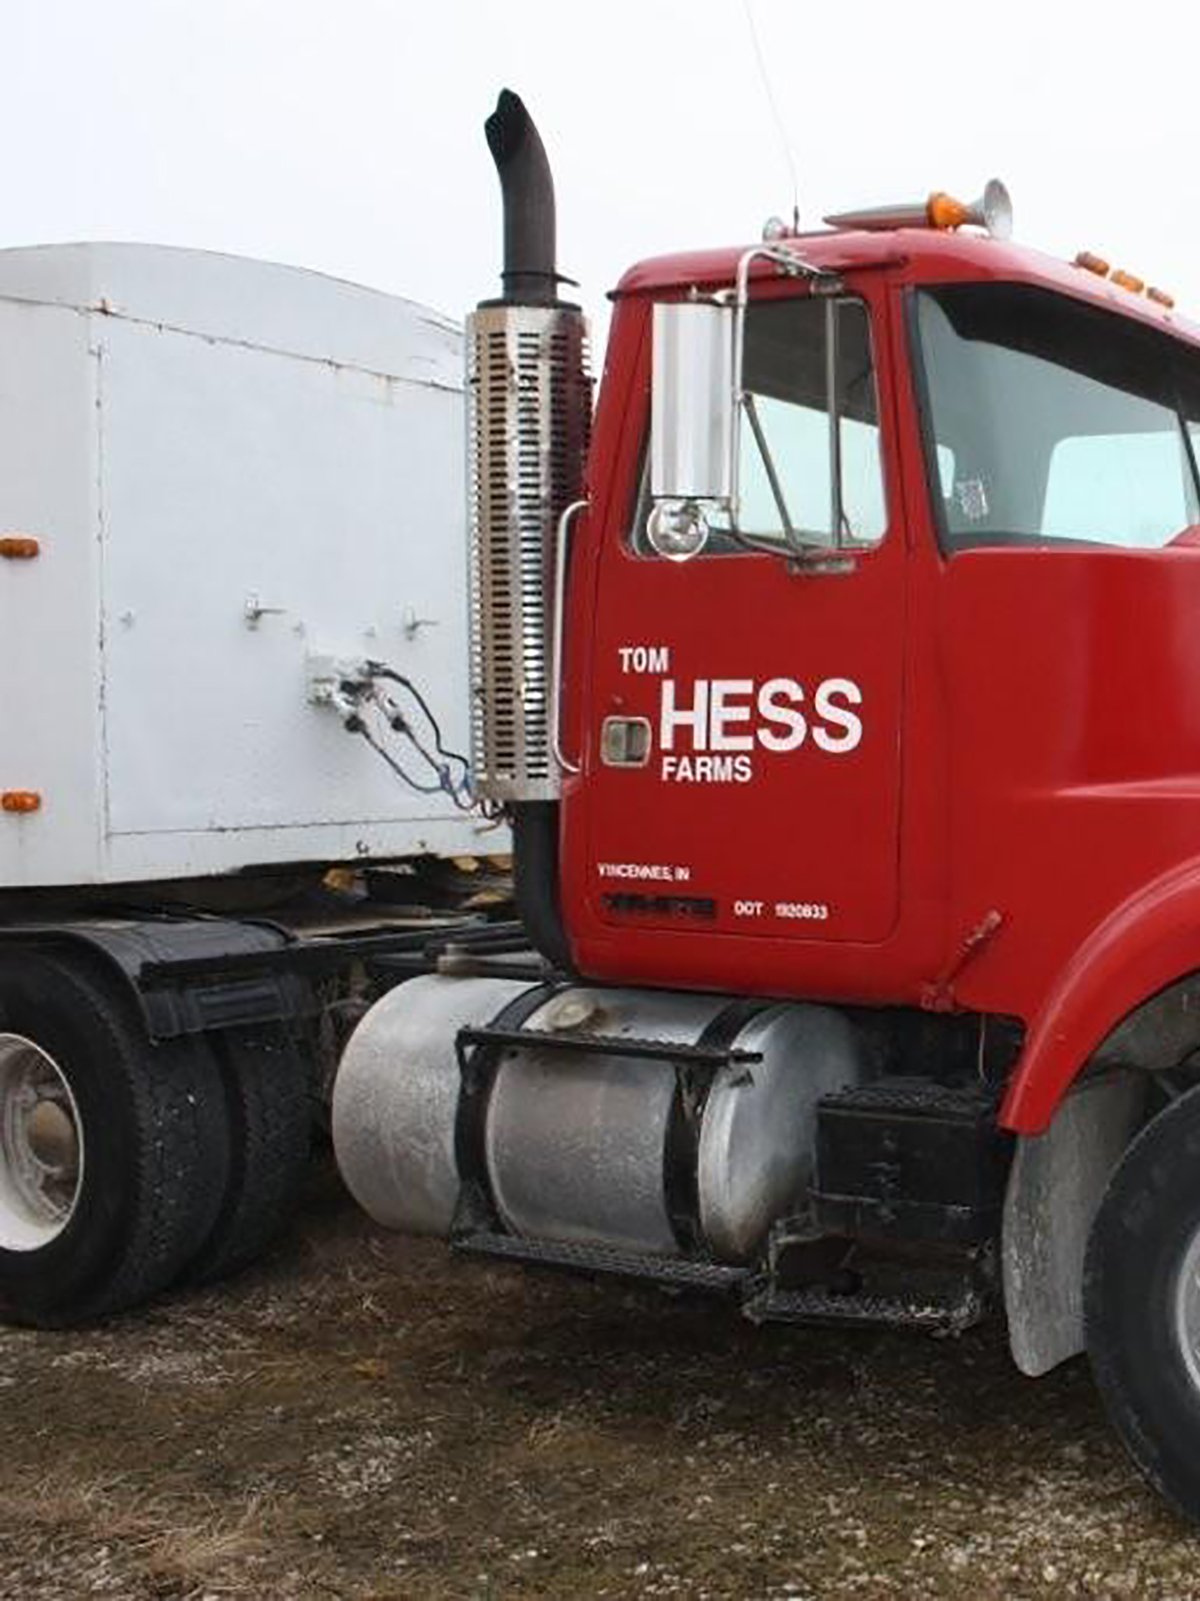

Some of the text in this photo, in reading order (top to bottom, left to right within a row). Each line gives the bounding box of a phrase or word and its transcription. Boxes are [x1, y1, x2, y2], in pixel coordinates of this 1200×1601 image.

[618, 646, 669, 674] TOM
[659, 677, 863, 753] HESS
[661, 755, 753, 783] FARMS
[674, 866, 690, 881] IN
[734, 900, 764, 916] DOT
